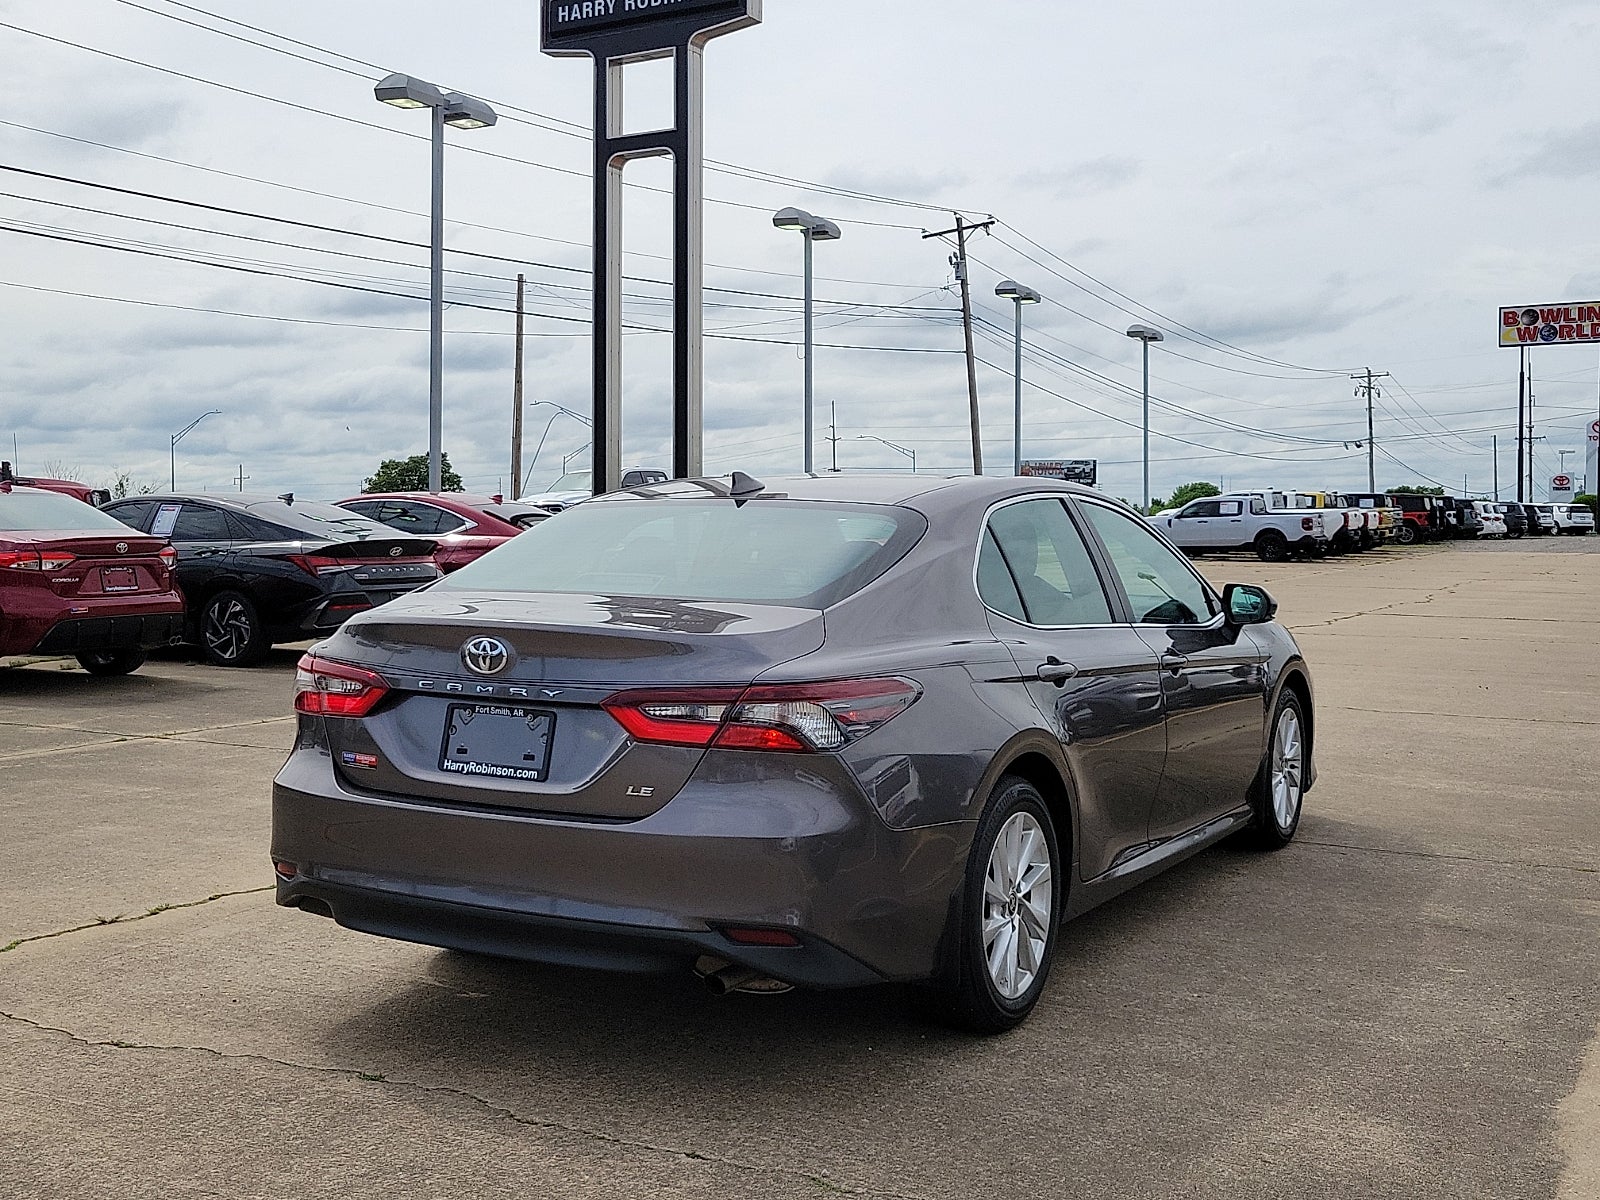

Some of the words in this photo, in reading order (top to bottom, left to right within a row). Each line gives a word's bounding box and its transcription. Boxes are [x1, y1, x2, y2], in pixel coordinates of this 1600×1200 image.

[558, 0, 615, 23] HARRY
[1516, 323, 1600, 342] WORLD
[419, 680, 563, 698] CAMRY
[475, 705, 489, 714] Fort
[490, 706, 512, 716] Smith,
[513, 709, 524, 717] AR
[443, 760, 538, 779] HarryRobinson.com
[626, 785, 655, 797] LE
